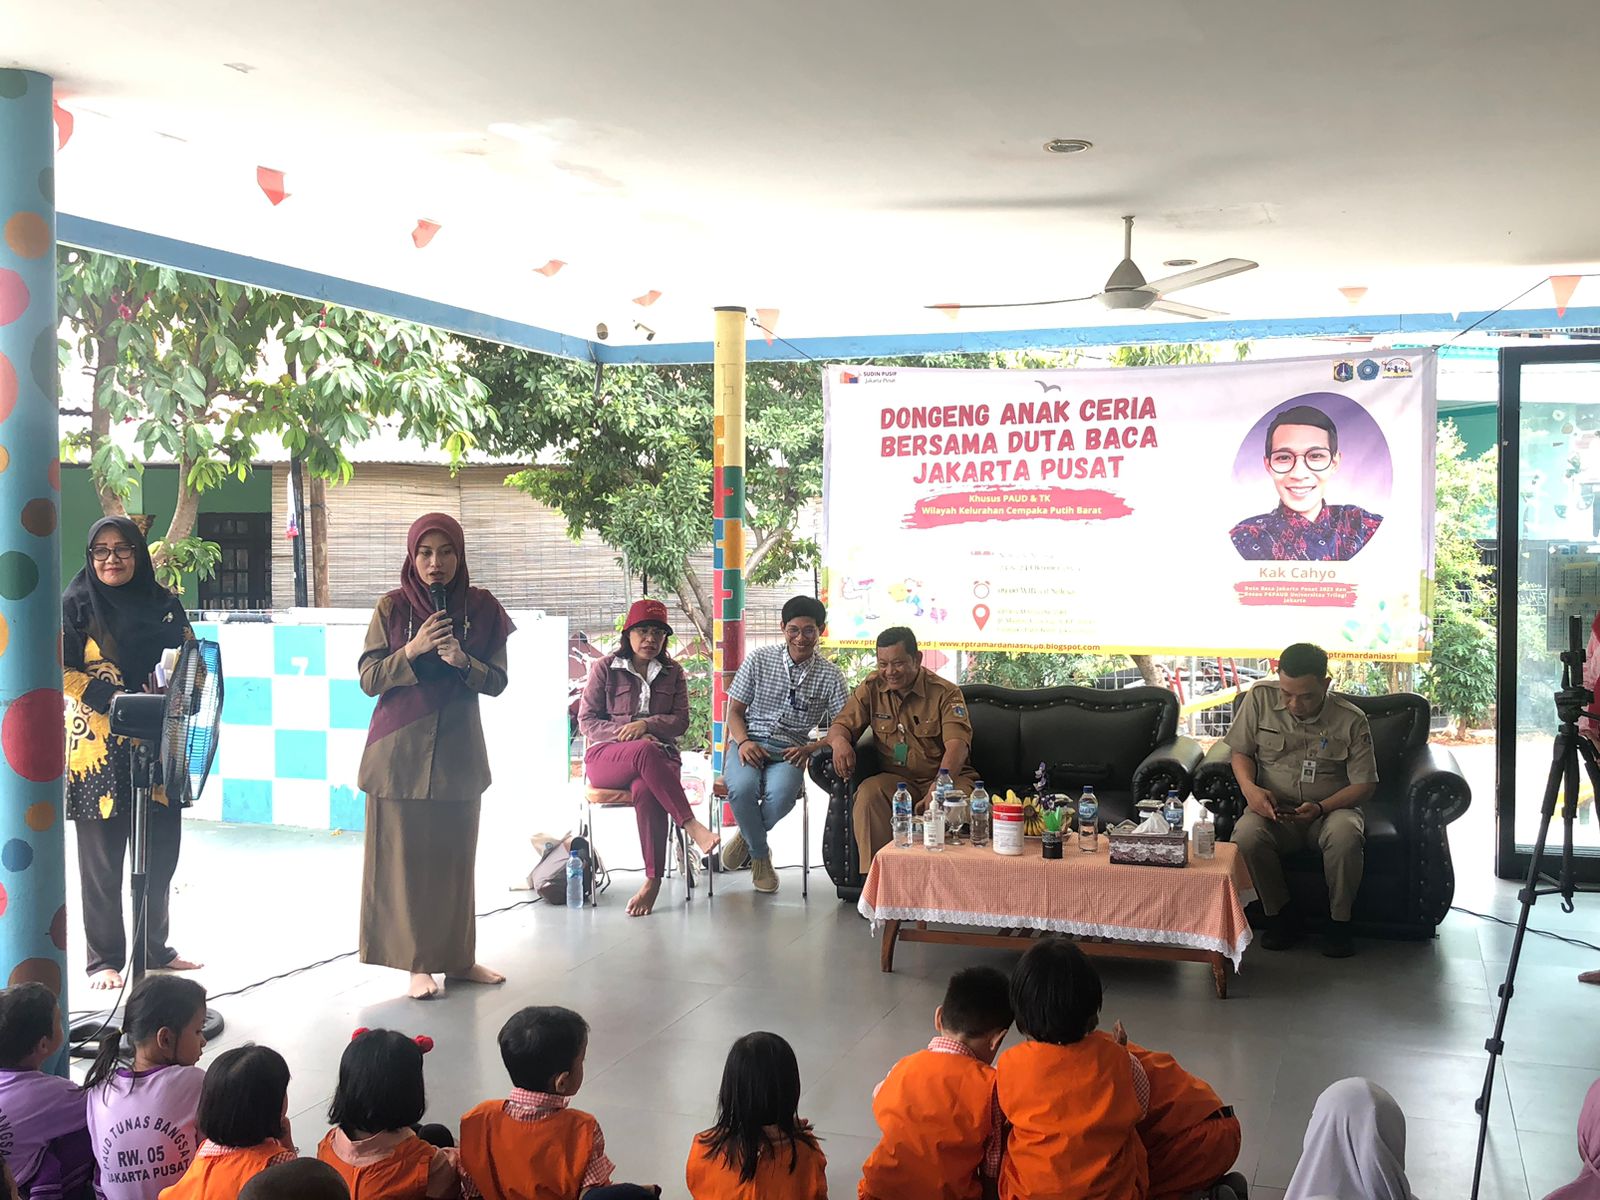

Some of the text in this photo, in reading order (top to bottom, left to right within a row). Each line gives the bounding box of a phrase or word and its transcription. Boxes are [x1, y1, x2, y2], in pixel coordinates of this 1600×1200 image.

[881, 397, 1157, 430] DONGENG ANAK CERIA
[880, 426, 1159, 458] BERSAMA DUTA BACA
[913, 456, 1125, 485] JAKARTA PUSAT
[921, 505, 1103, 516] Wilayah Kelurahan Cempaka Putih Barat
[968, 494, 1051, 504] Khusus PAUD & TK
[1259, 567, 1337, 581] Kak Cahyo
[103, 1115, 190, 1170] PAUD TUNAS BANGSA
[117, 1145, 165, 1168] RW. 05
[153, 1158, 190, 1179] PUSAT
